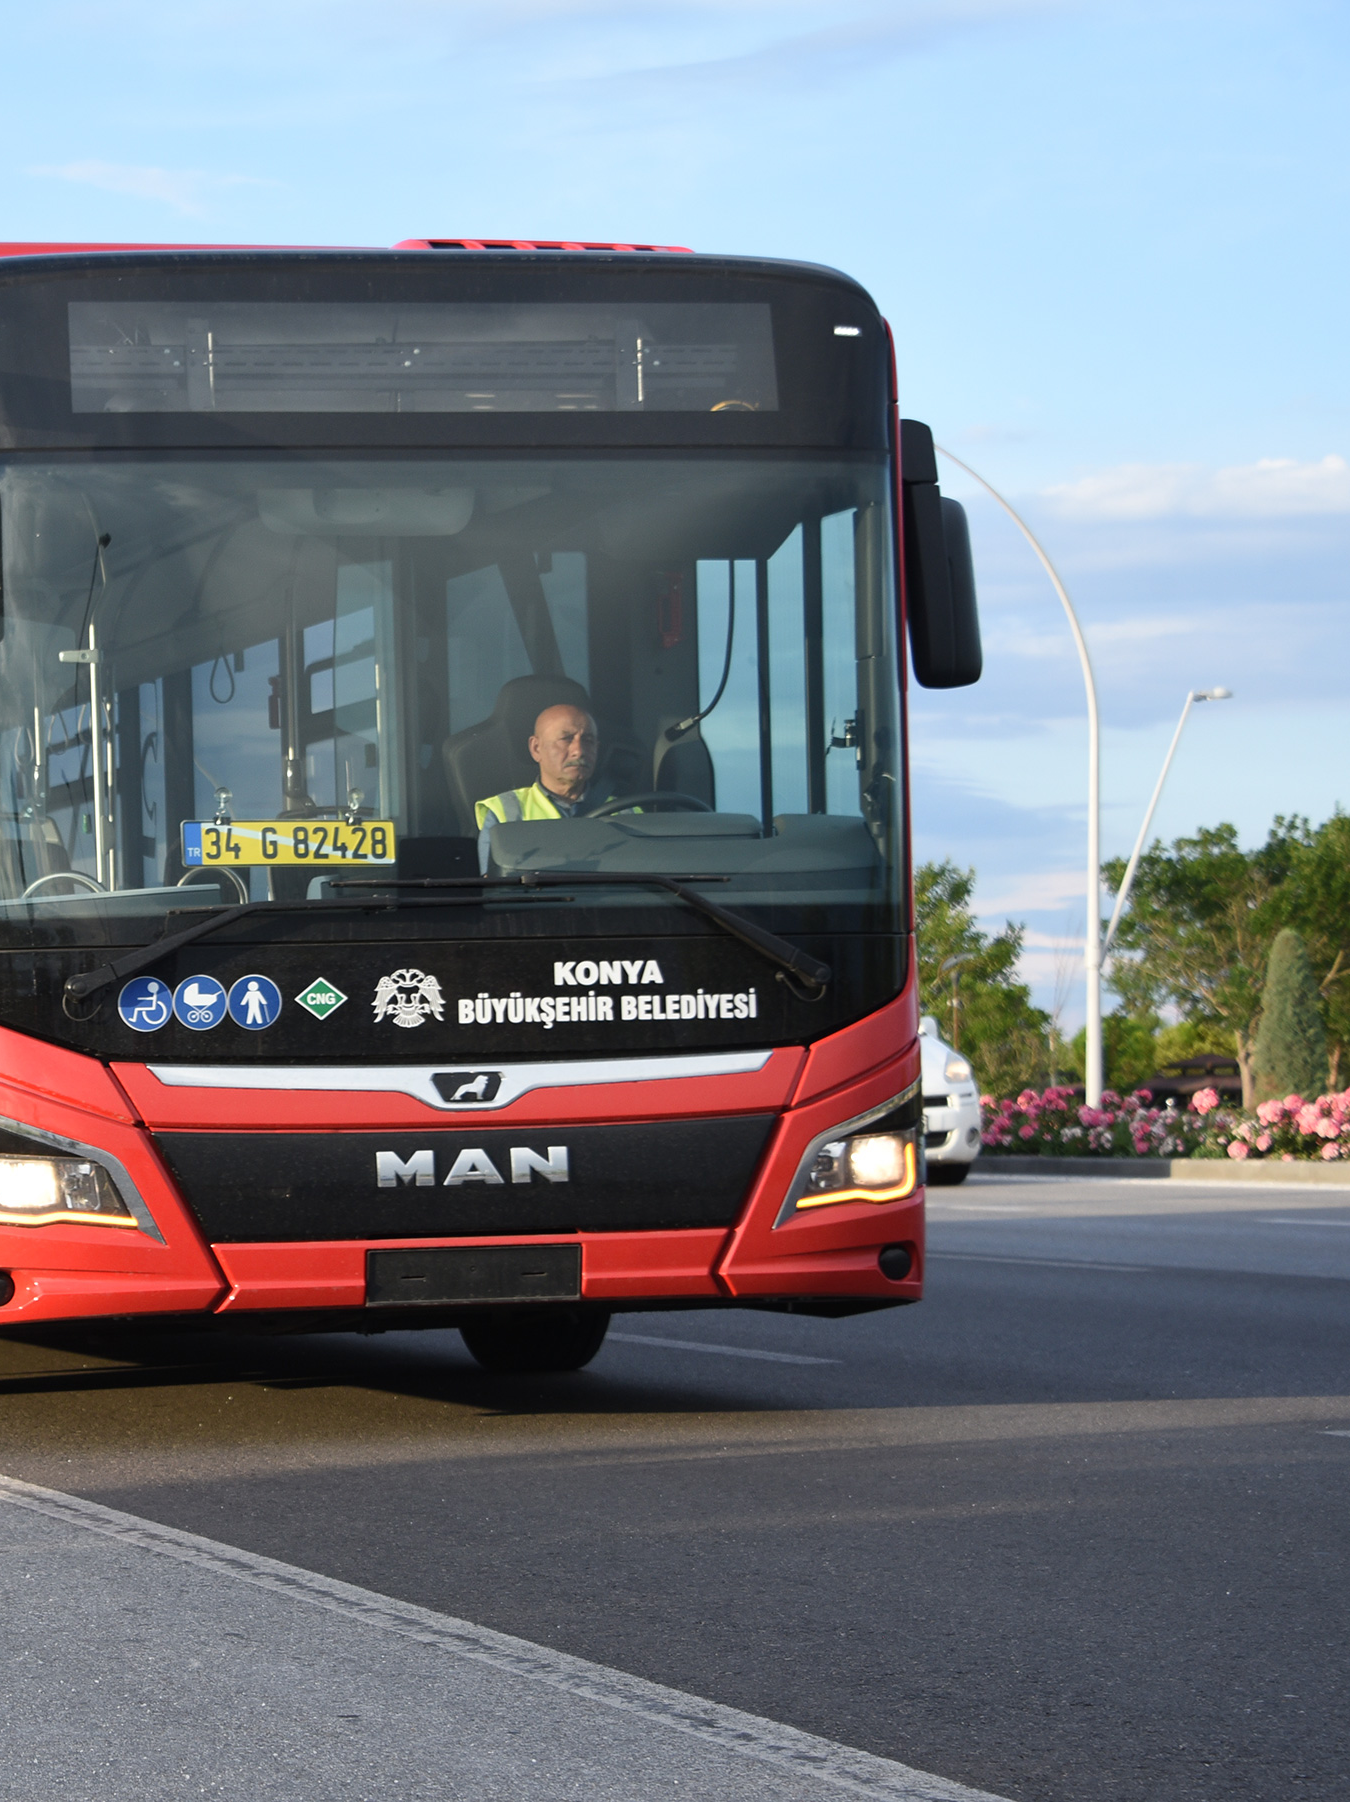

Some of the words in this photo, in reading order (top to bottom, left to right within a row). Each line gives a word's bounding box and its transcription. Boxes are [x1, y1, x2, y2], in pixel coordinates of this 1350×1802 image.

[187, 847, 200, 857] TR
[204, 827, 242, 860] 34
[261, 826, 278, 860] G
[293, 826, 387, 860] 82428
[553, 960, 664, 986] KONYA
[306, 992, 337, 1006] CNG
[458, 991, 614, 1029] BÜYÜKŞEHİR
[621, 987, 757, 1021] BELEDİYESİ
[375, 1145, 569, 1188] MAN
